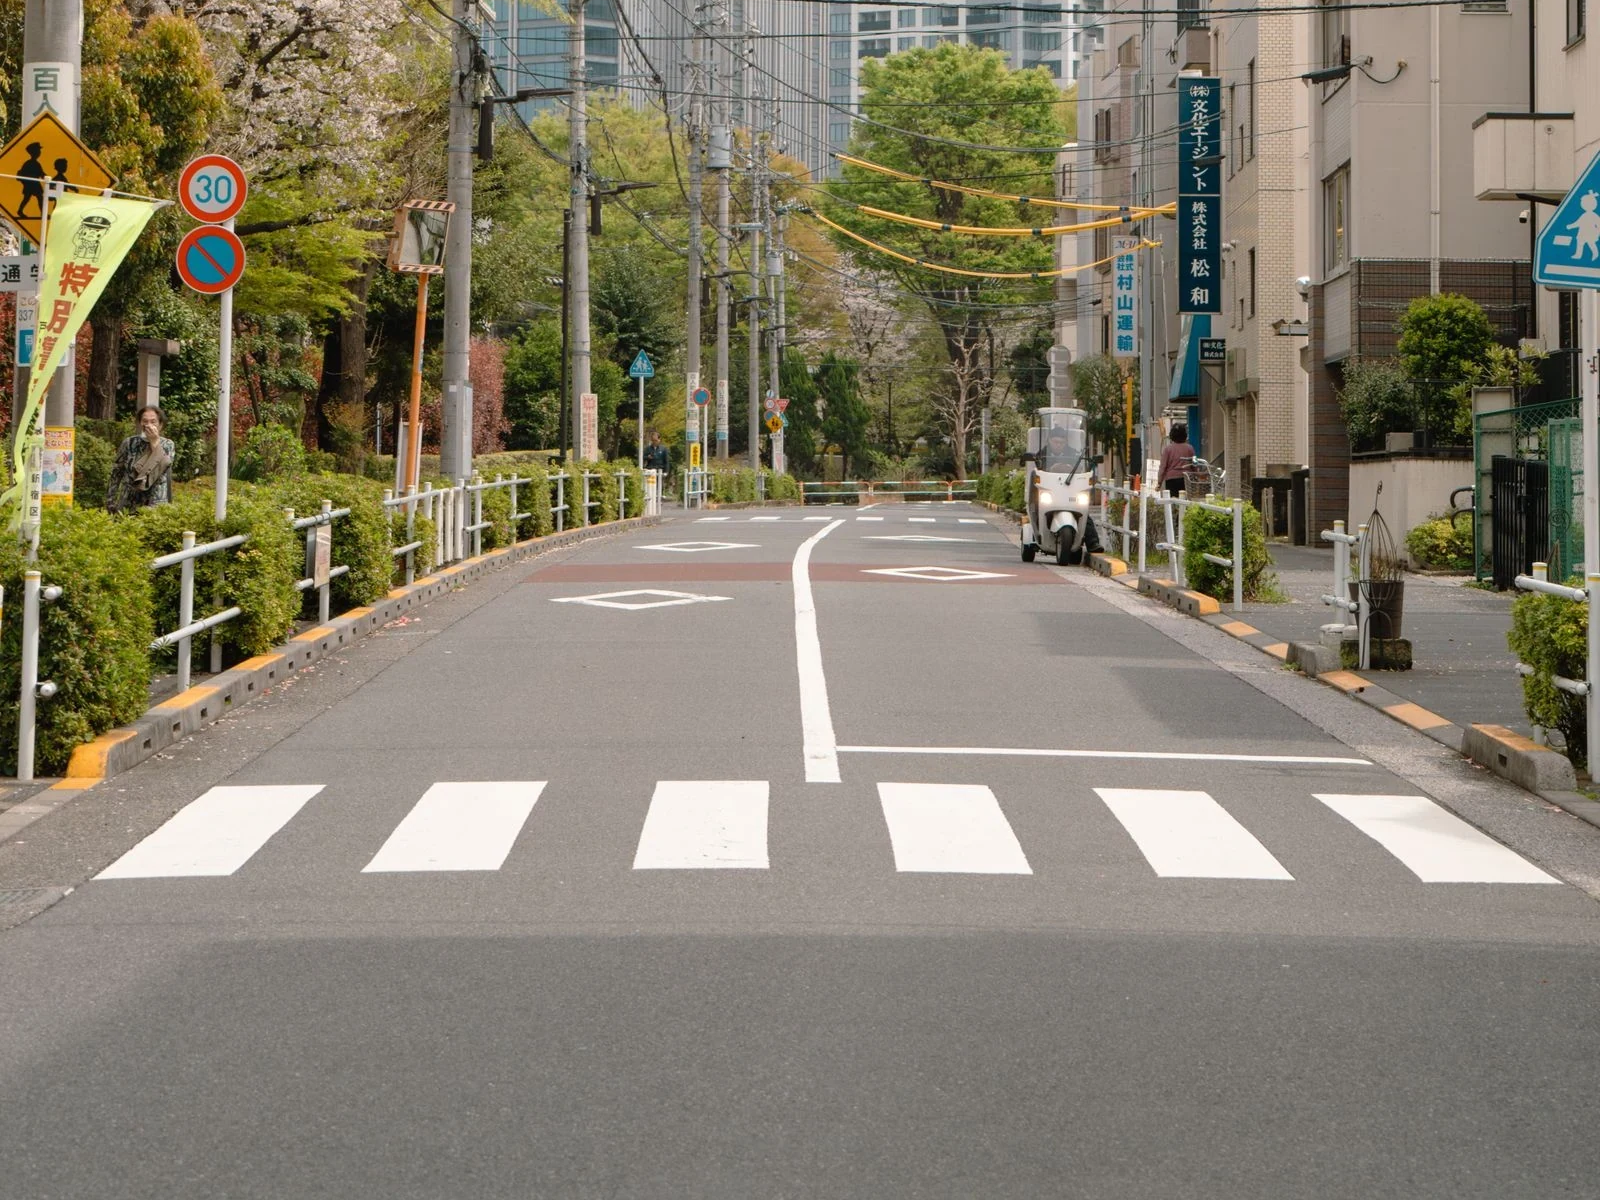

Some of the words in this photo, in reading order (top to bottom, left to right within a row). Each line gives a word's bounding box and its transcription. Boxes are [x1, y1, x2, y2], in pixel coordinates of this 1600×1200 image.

[195, 175, 232, 204] 30
[1117, 274, 1133, 351] 村山運輸
[30, 473, 41, 517] 新宿区
